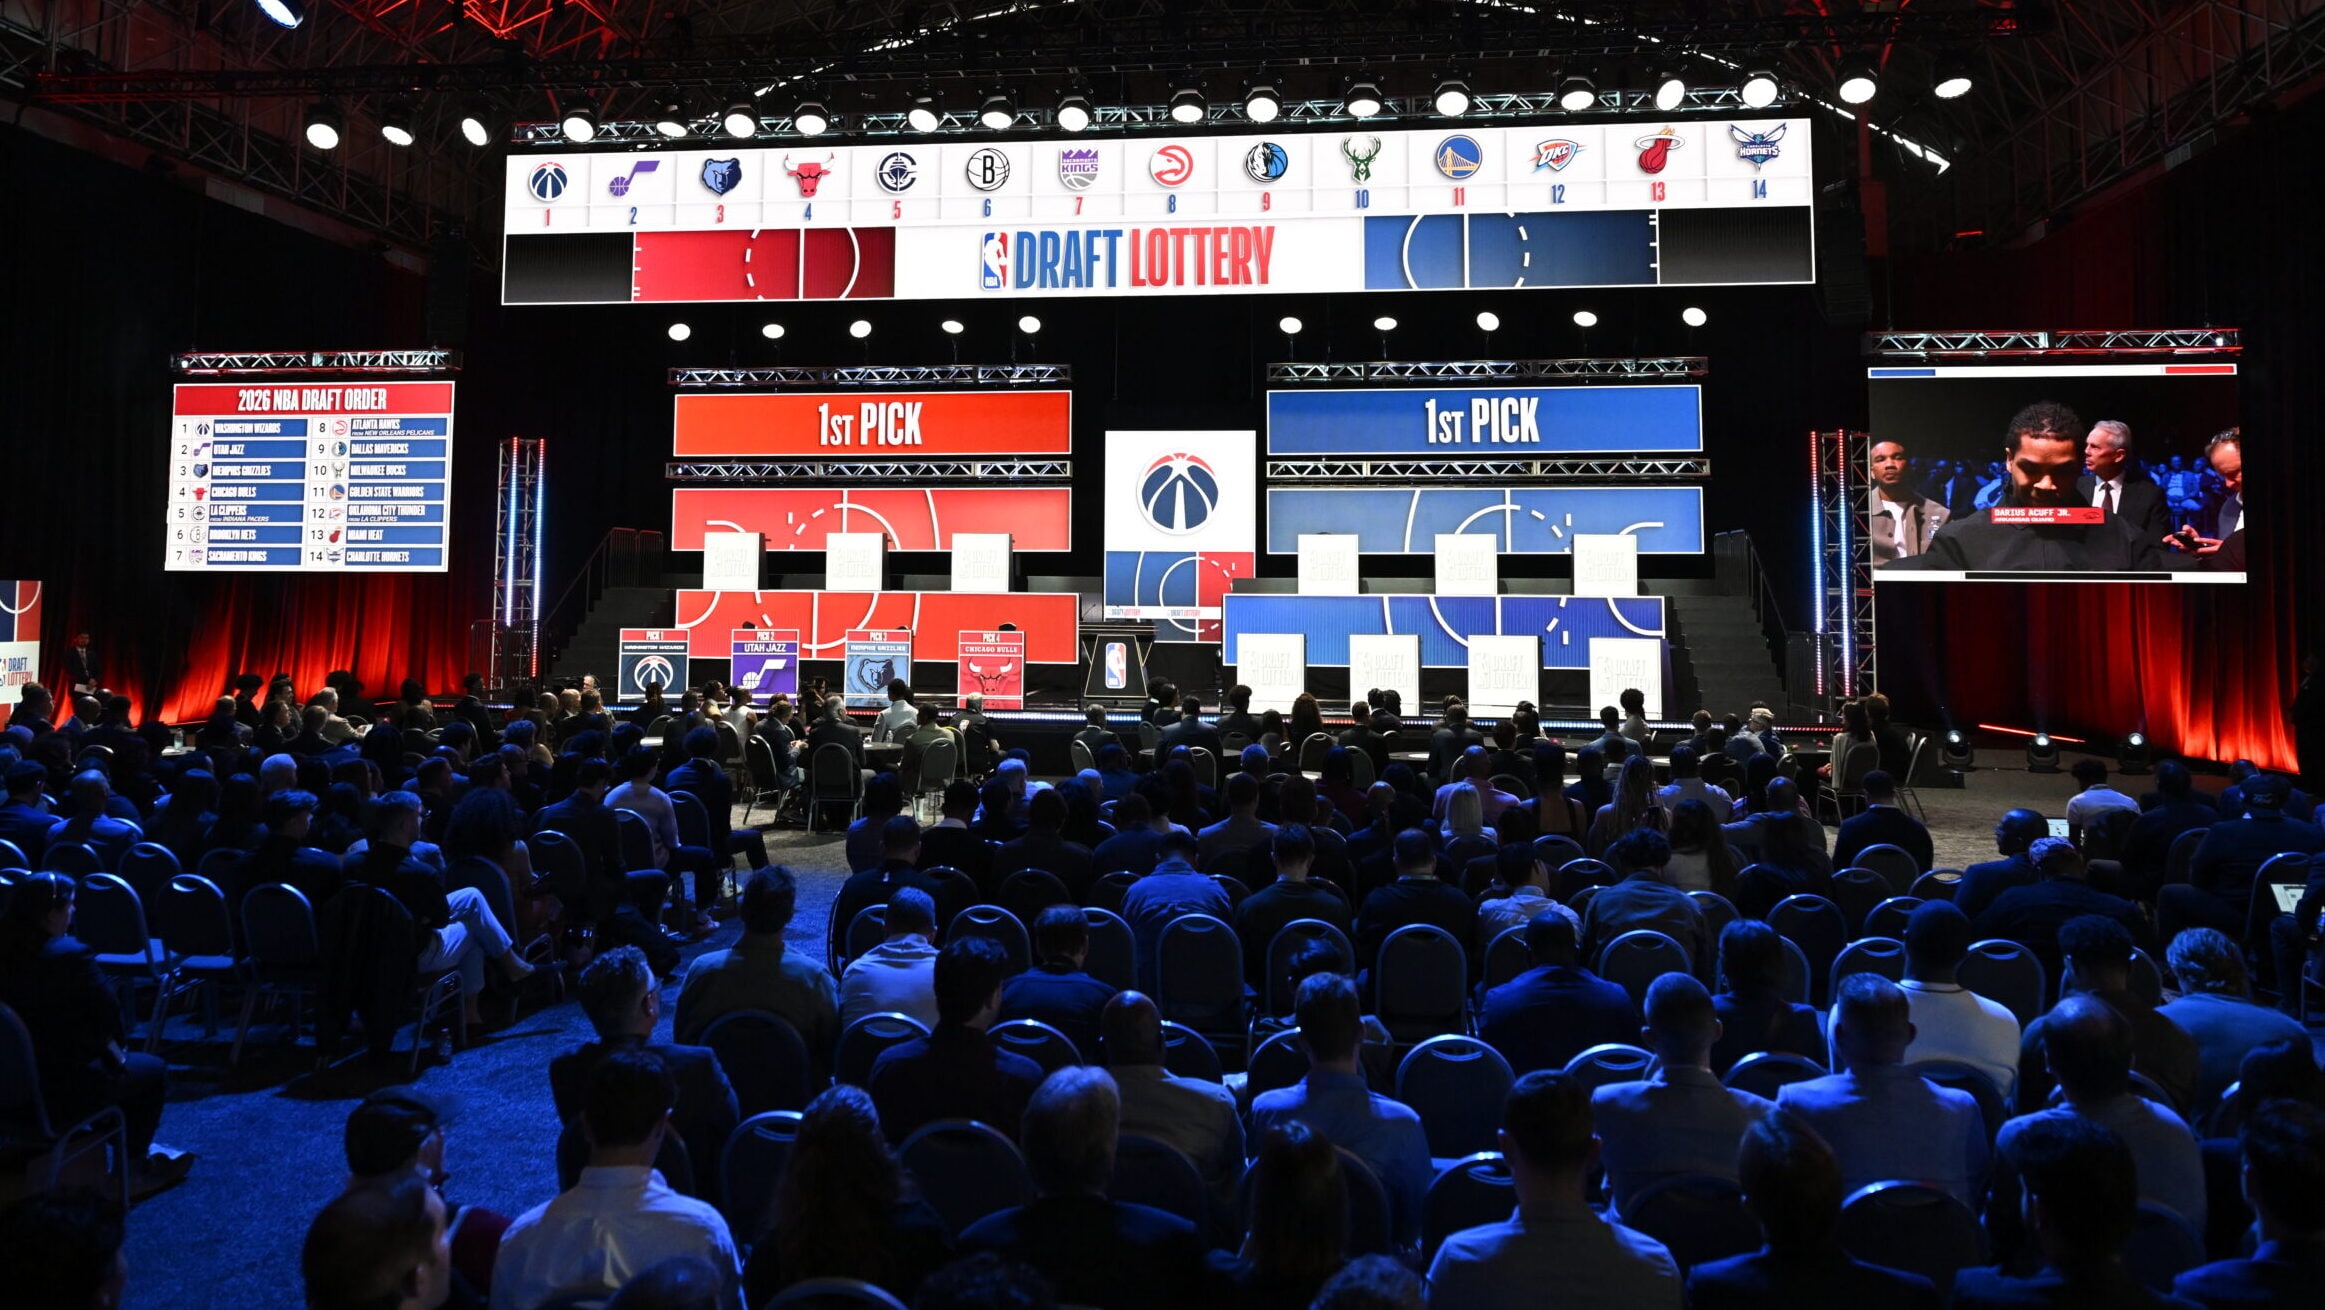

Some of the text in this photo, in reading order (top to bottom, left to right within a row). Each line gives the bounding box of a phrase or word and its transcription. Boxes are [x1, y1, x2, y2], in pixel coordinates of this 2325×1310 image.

[1740, 146, 1779, 156] HORNETS
[1062, 164, 1098, 173] KINGS
[546, 180, 1767, 226] 1 2 3 4 5 6 7 8 9 10 11 12 13 14
[1015, 226, 1275, 289] DRAFT LOTTERY
[238, 388, 387, 411] 2026 NBA DRAFT ORDER
[818, 401, 923, 446] 1ST PICK
[1424, 396, 1541, 445] 1ST PICK
[183, 424, 186, 432] 1
[320, 423, 325, 432] 8
[182, 445, 187, 454] 2
[319, 444, 324, 454] 9
[181, 466, 186, 476] 3
[314, 465, 326, 475] 10
[179, 487, 185, 496] 4
[313, 488, 324, 496] 11
[179, 508, 184, 518] 5
[312, 508, 324, 518] 12
[1994, 508, 2071, 517] DARIUS ACUFF JR.
[177, 530, 183, 539] 6
[312, 530, 323, 540] 13
[177, 551, 182, 560] 7
[310, 552, 322, 561] 14
[744, 643, 787, 652] UTAH JAZZ
[8, 657, 28, 672] DRAFT
[8, 671, 33, 686] LOTTERY
